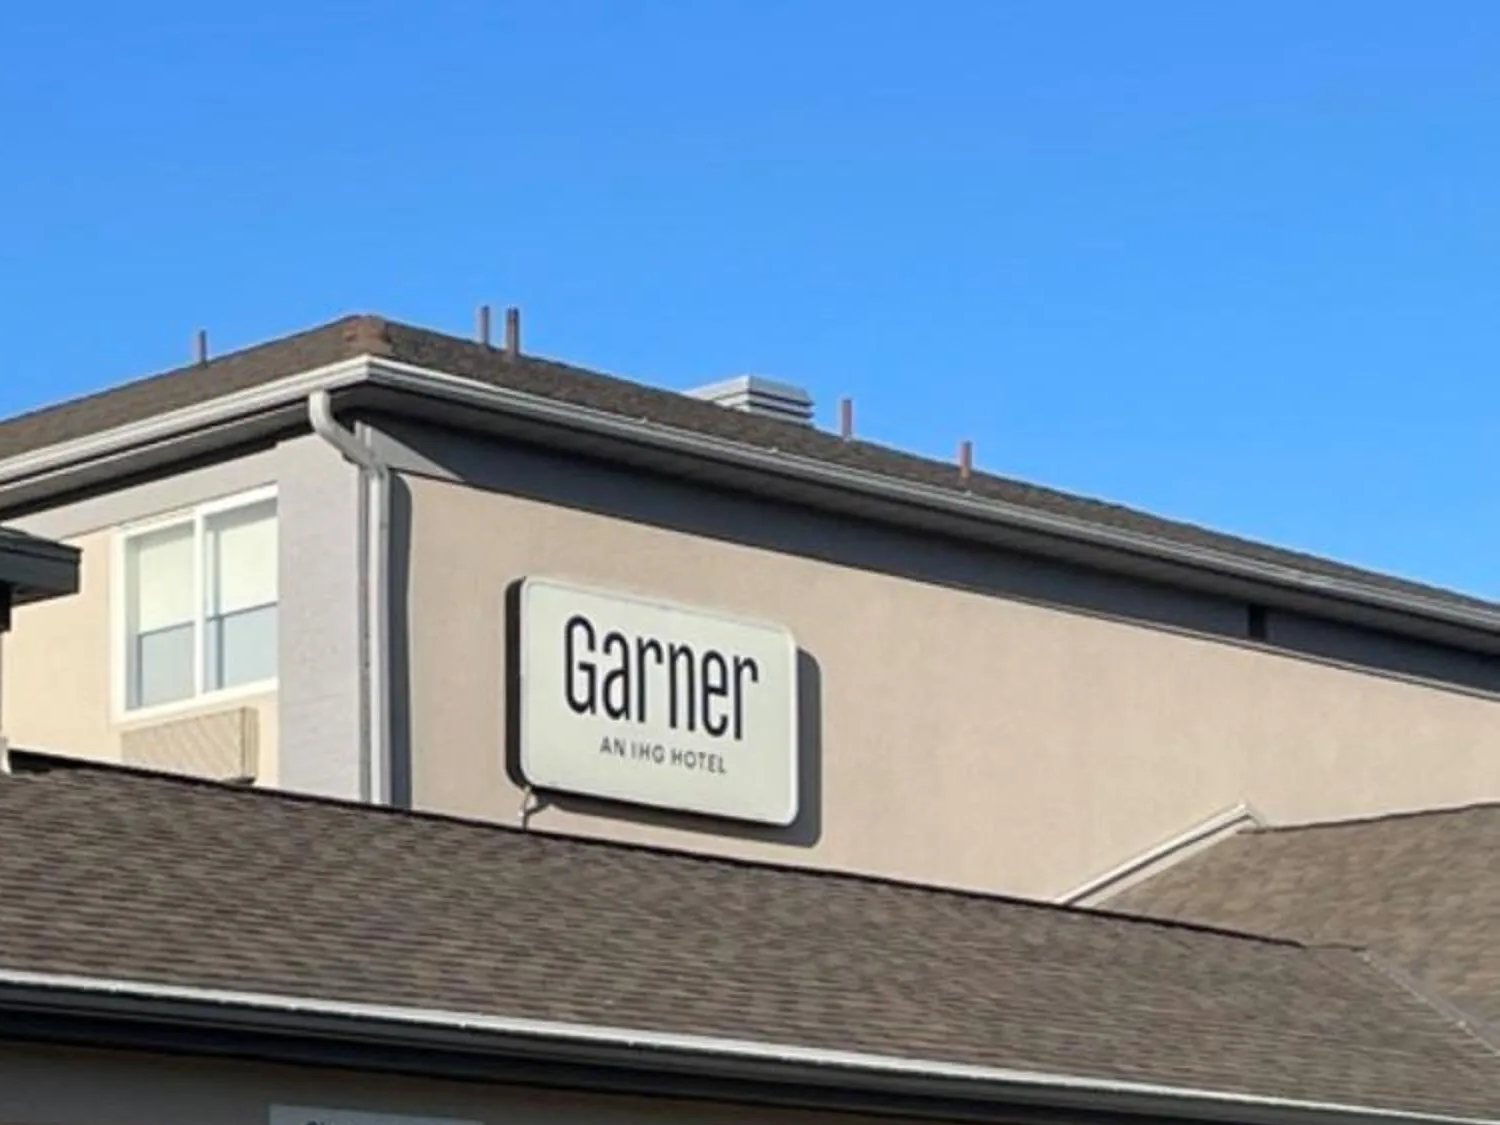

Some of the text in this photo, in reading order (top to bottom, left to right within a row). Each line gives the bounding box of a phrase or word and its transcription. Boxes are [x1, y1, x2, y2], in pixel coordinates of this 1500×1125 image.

[564, 614, 758, 741] Garner
[599, 735, 727, 774] AN IHG HOTEL
